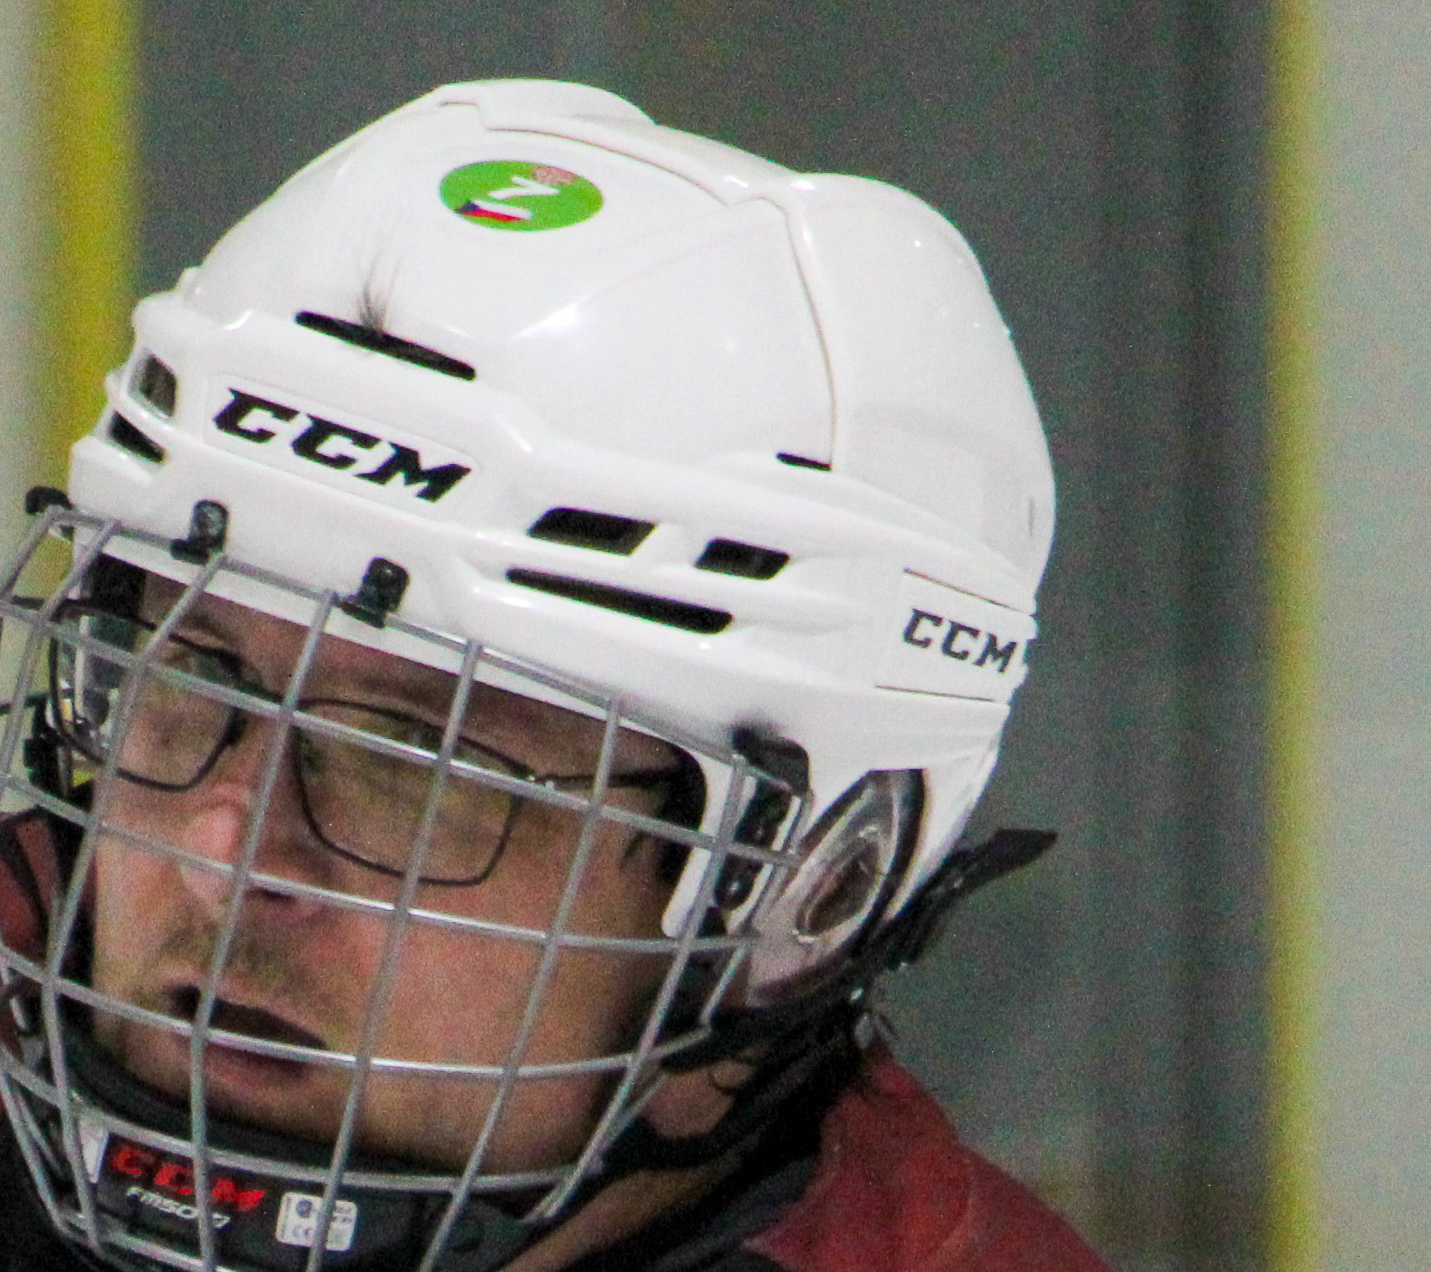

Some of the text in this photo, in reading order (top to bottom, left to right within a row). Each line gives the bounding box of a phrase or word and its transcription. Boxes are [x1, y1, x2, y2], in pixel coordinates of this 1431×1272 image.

[213, 387, 473, 504] CCM
[903, 608, 1018, 673] CCM
[112, 1147, 266, 1212] CCM
